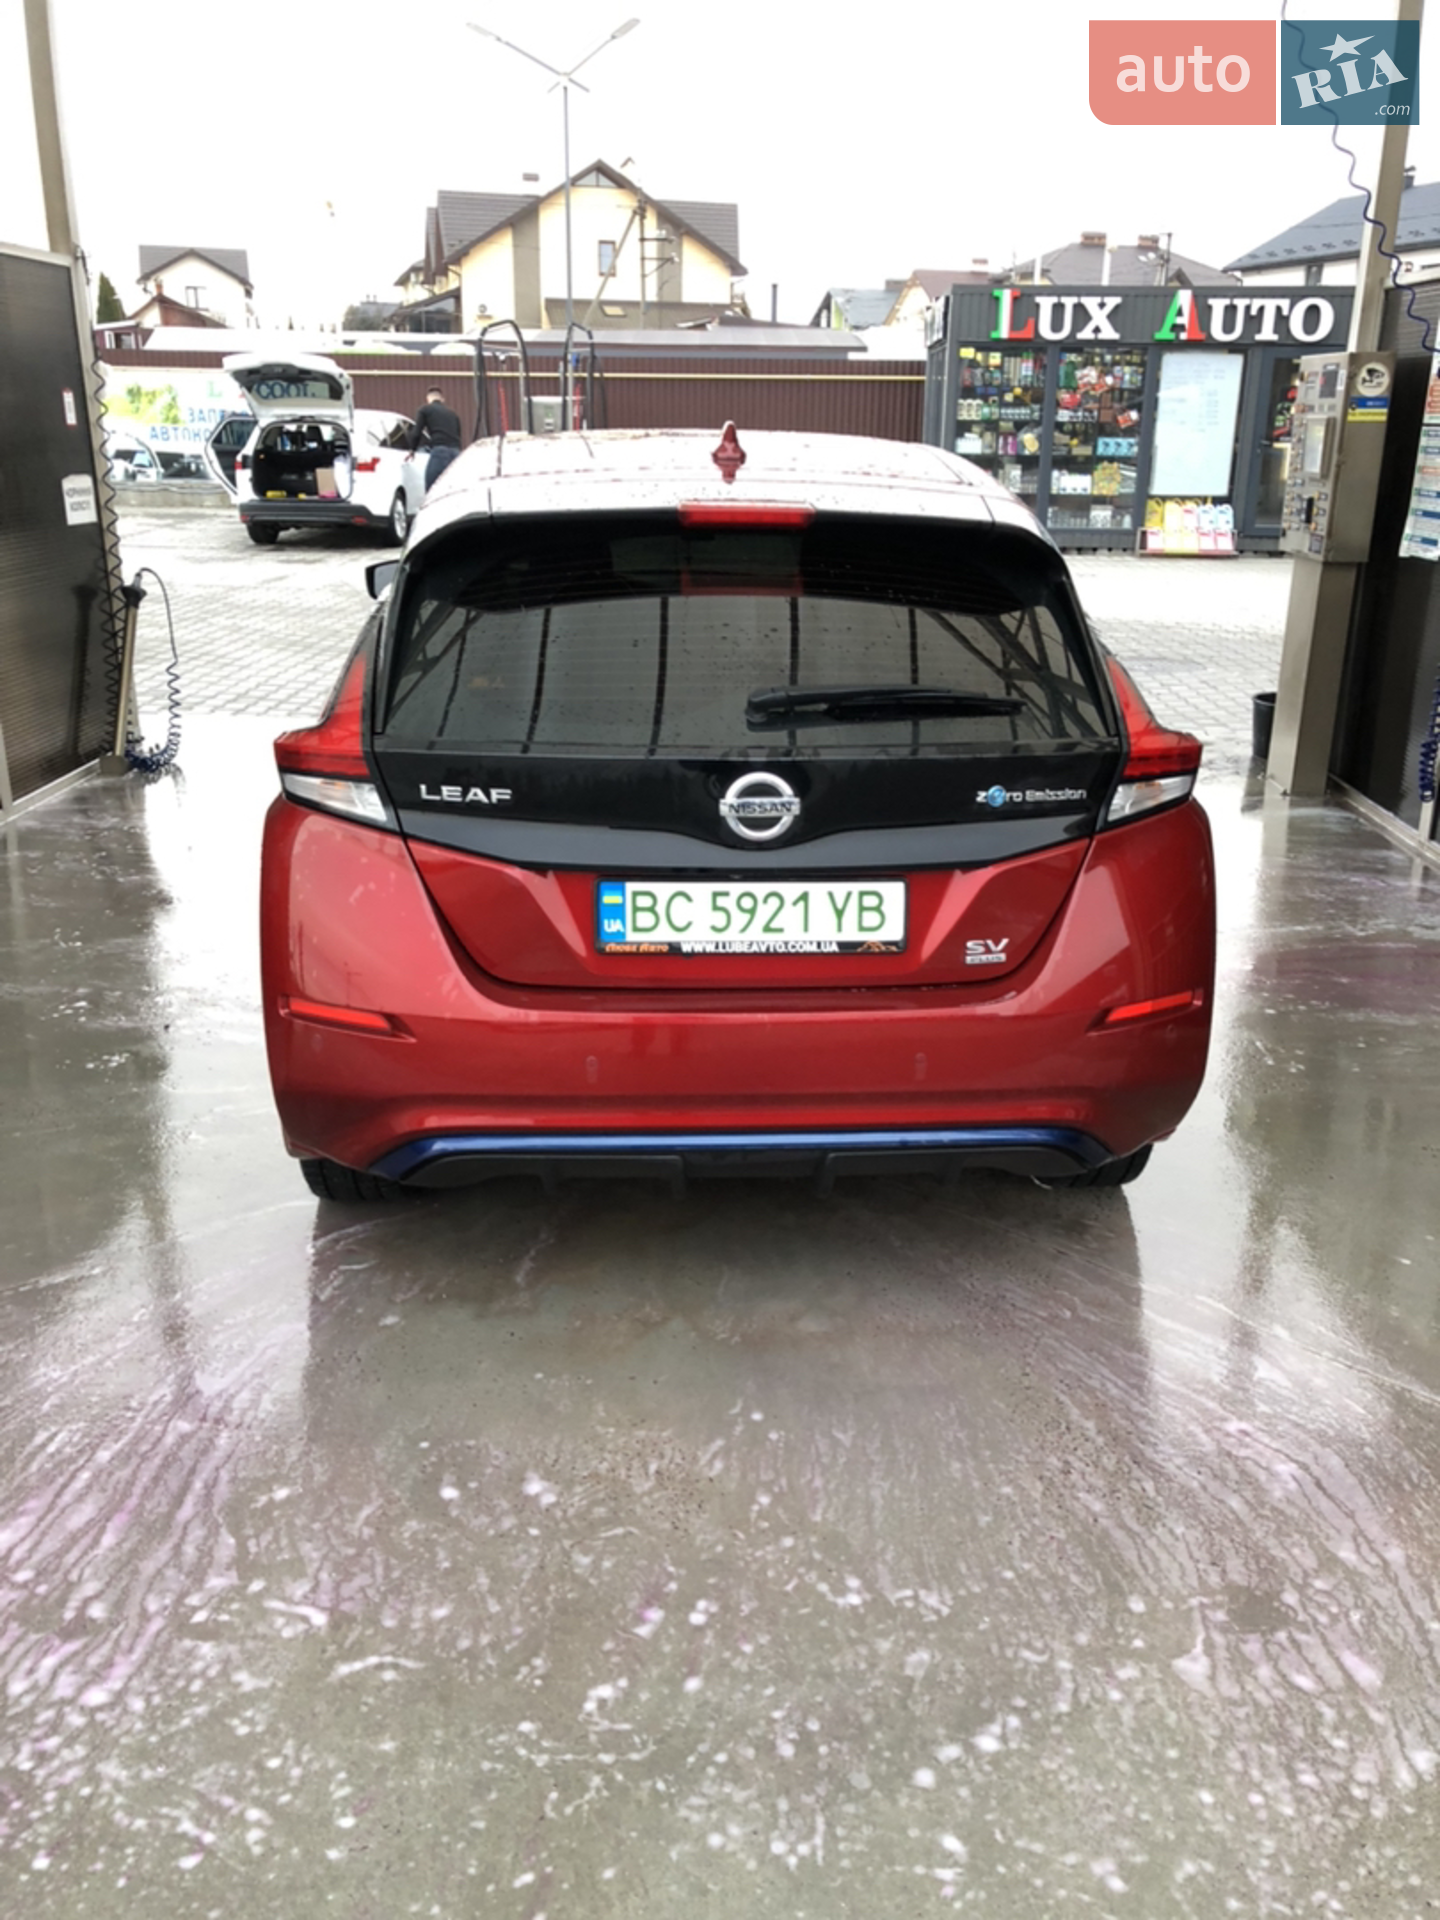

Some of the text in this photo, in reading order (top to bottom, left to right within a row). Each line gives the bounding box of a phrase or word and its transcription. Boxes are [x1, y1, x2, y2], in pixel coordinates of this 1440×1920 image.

[990, 288, 1123, 342] LUX
[1154, 288, 1336, 343] AUTO
[419, 783, 513, 804] LEAF
[1025, 787, 1087, 803] Emission
[727, 801, 793, 815] NISSAN
[630, 890, 888, 934] BC 5921 YB
[603, 918, 625, 932] UA
[965, 938, 1010, 954] SV
